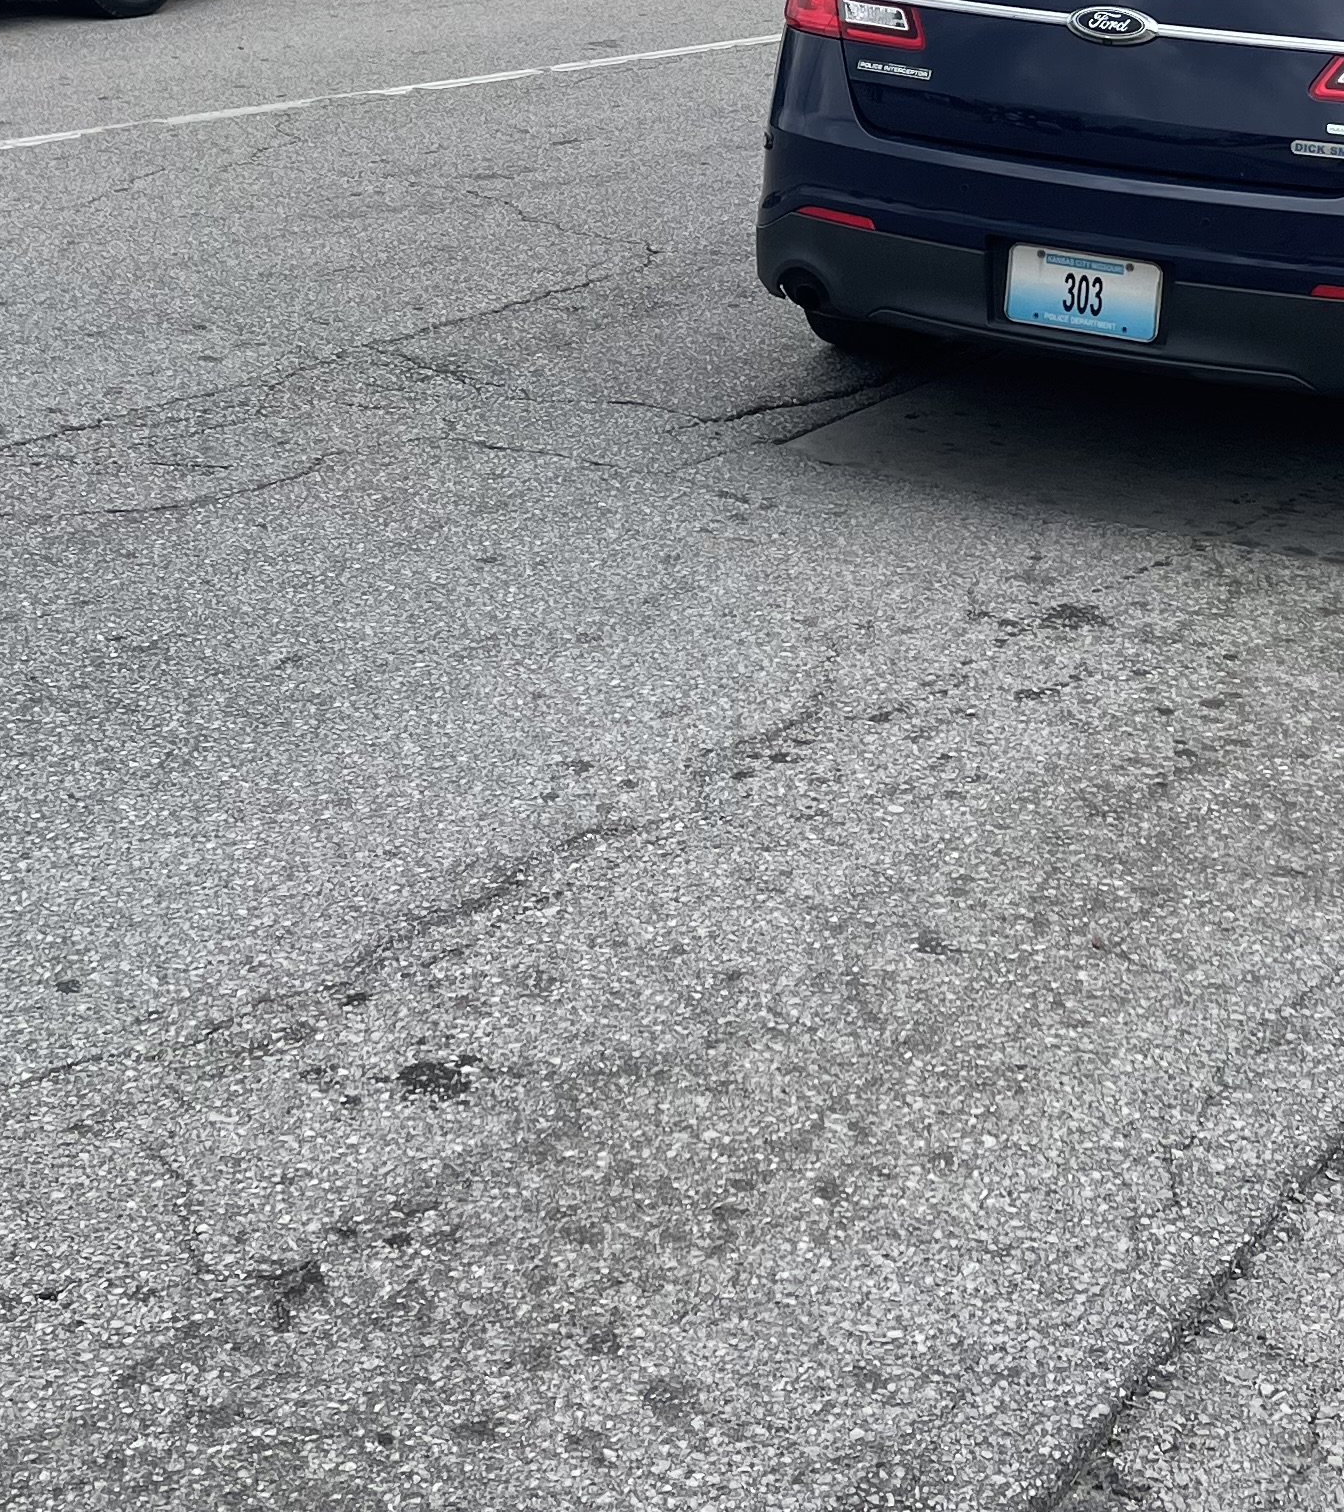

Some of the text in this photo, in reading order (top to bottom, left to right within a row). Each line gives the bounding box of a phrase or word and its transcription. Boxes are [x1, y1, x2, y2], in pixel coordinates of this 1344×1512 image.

[1088, 11, 1131, 32] Ford
[860, 61, 928, 77] POLICE INTERCEPTOR
[1294, 143, 1325, 155] DICK
[1047, 255, 1124, 274] KANSAS CITY MISSOURI
[1062, 272, 1104, 316] 303
[1043, 312, 1117, 330] POLICE DEPARTMENT
